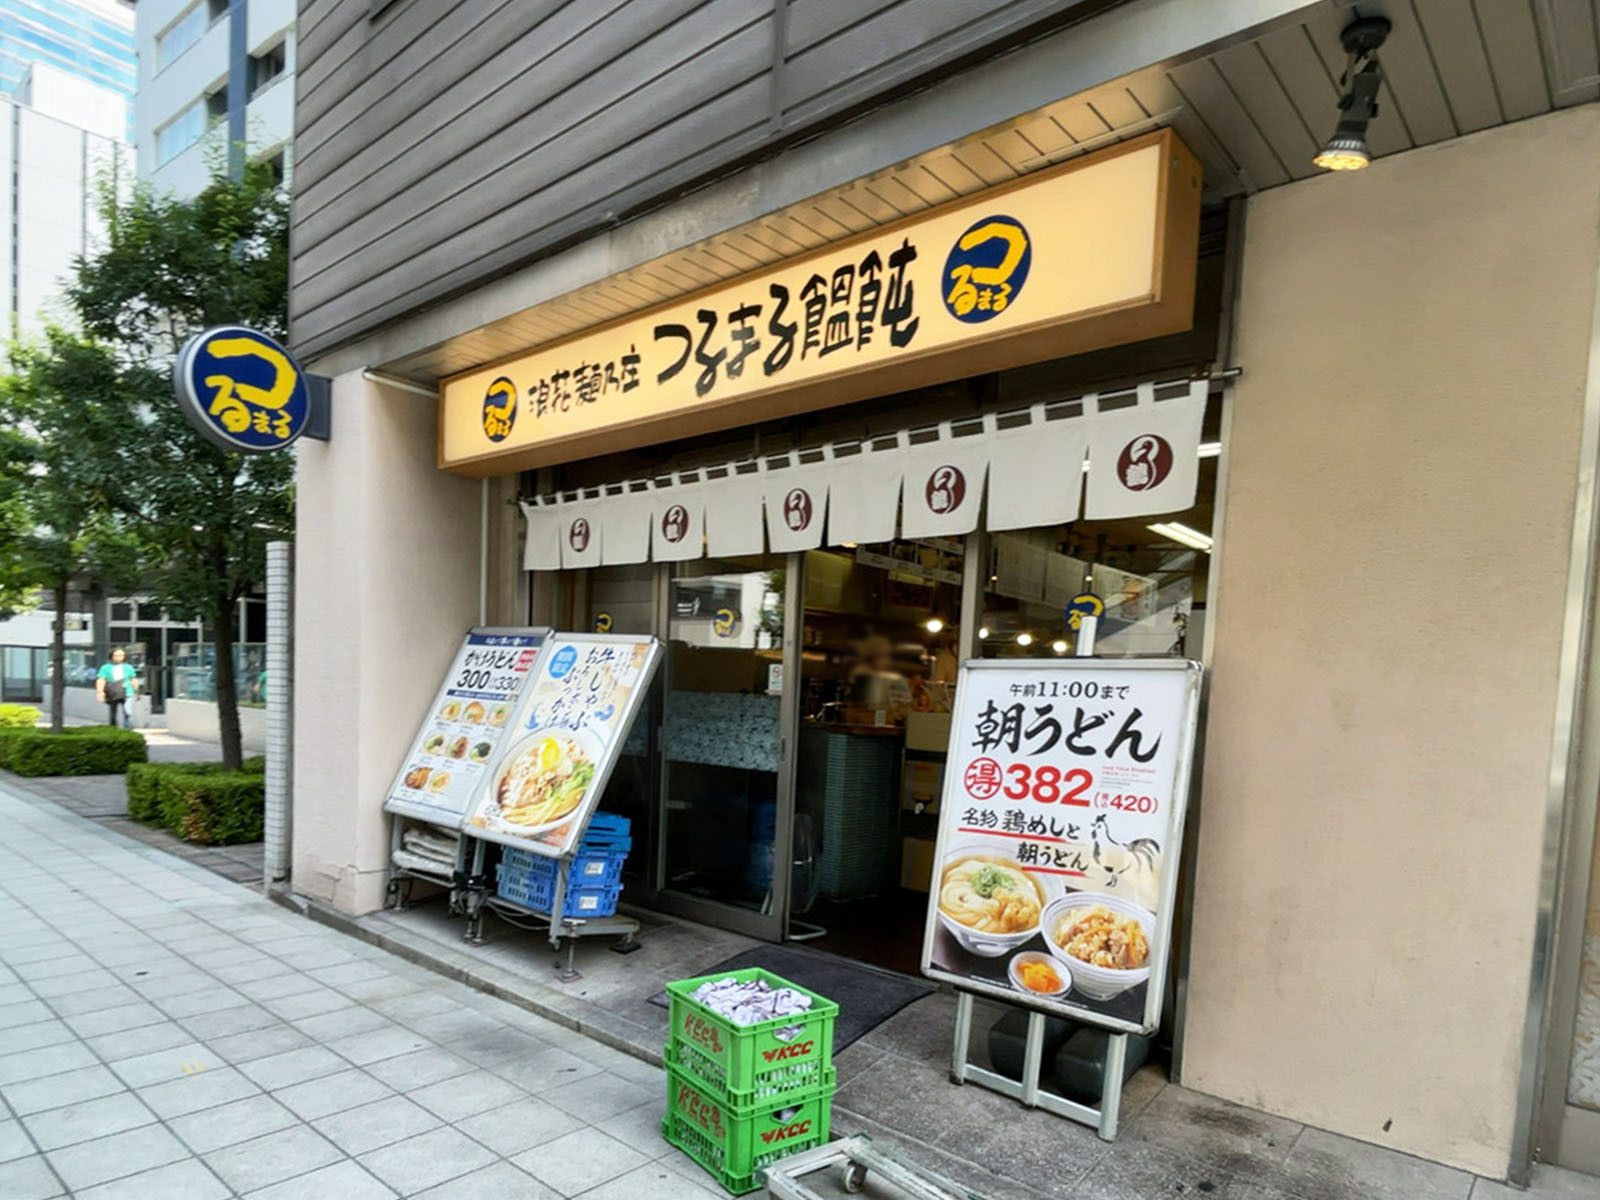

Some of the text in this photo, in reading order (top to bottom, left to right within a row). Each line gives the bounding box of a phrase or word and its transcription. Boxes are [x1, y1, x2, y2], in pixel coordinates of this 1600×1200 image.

[654, 237, 919, 397] つるまる饂飩
[457, 669, 491, 689] 300
[1009, 681, 1130, 700] 午前11:00まで
[972, 699, 1162, 763] 朝うどん
[1003, 763, 1093, 808] 382
[961, 807, 1081, 839] 名物 鶏めしと
[1016, 841, 1089, 871] 朝うどん
